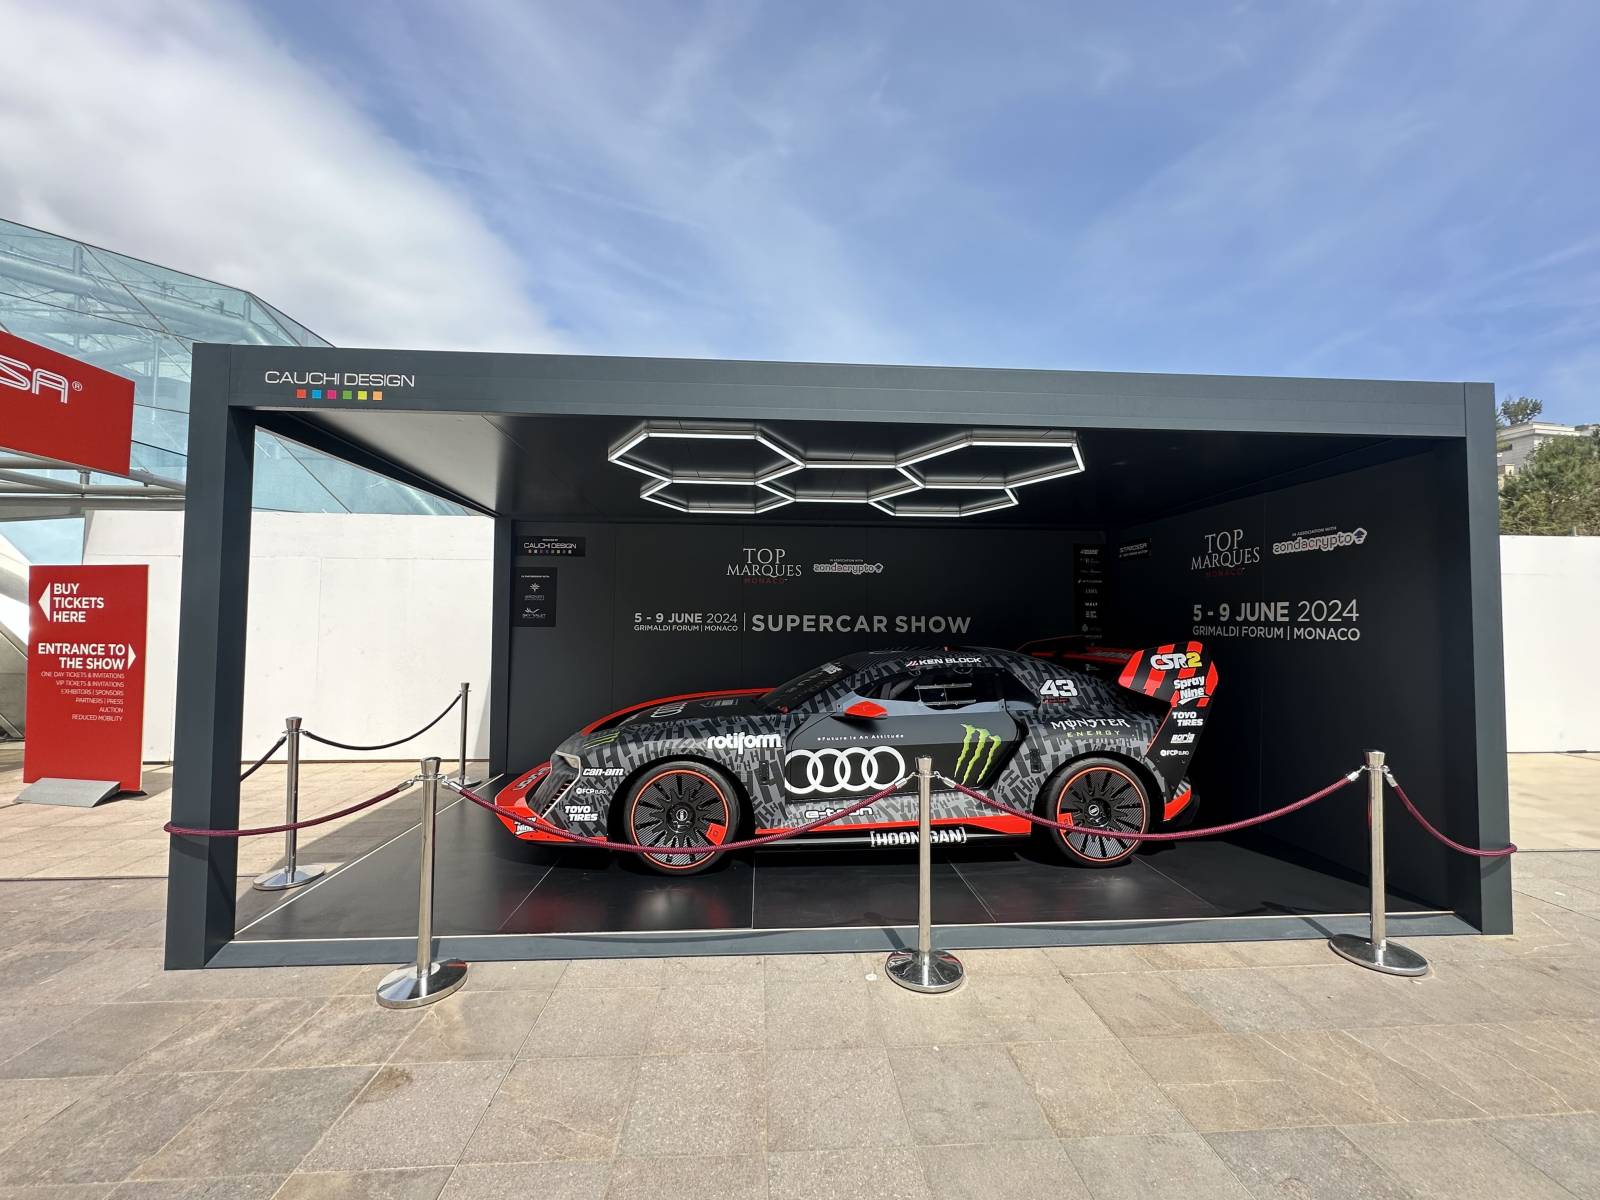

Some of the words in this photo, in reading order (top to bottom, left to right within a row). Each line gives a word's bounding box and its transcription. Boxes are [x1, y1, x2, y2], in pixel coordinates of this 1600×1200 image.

[264, 371, 340, 386] CAUCHI
[344, 373, 415, 388] DESIGN
[1204, 528, 1244, 554] TOP
[743, 548, 786, 564] TOP
[1190, 547, 1261, 571] MARQUES
[726, 563, 802, 578] MARQUES
[53, 583, 80, 594] BUY
[53, 597, 104, 608] TICKETS
[53, 611, 86, 622] HERE
[1192, 604, 1202, 622] 5
[1219, 603, 1230, 622] 9
[1235, 601, 1290, 622] JUNE
[1296, 598, 1360, 622] 2024
[634, 612, 642, 623] 5
[656, 612, 664, 623] 9
[668, 612, 702, 623] JUNE
[706, 613, 738, 624] 2024
[752, 614, 888, 632] SUPERCAR
[895, 616, 971, 634] SHOW
[672, 624, 700, 632] FORUM
[1192, 625, 1240, 637] GRIMALDI
[1242, 626, 1284, 638] FORUM
[1293, 627, 1361, 642] MONACO
[38, 643, 105, 654] ENTRANCE
[108, 644, 126, 656] TO
[59, 657, 83, 668] THE
[86, 658, 125, 670] SHOW
[920, 658, 944, 666] KEN
[1150, 652, 1202, 670] CSR2
[1040, 680, 1078, 697] 43
[1174, 676, 1205, 690] Spray
[1180, 687, 1205, 700] Nine
[1172, 712, 1196, 720] TOYO
[1050, 718, 1131, 730] MONSTER
[1066, 730, 1120, 738] ENERGY
[706, 732, 782, 754] rotiform
[582, 768, 624, 776] can-am
[565, 806, 591, 814] TOYO
[568, 814, 598, 822] TIRES
[870, 826, 968, 848] [HOONGAN]
